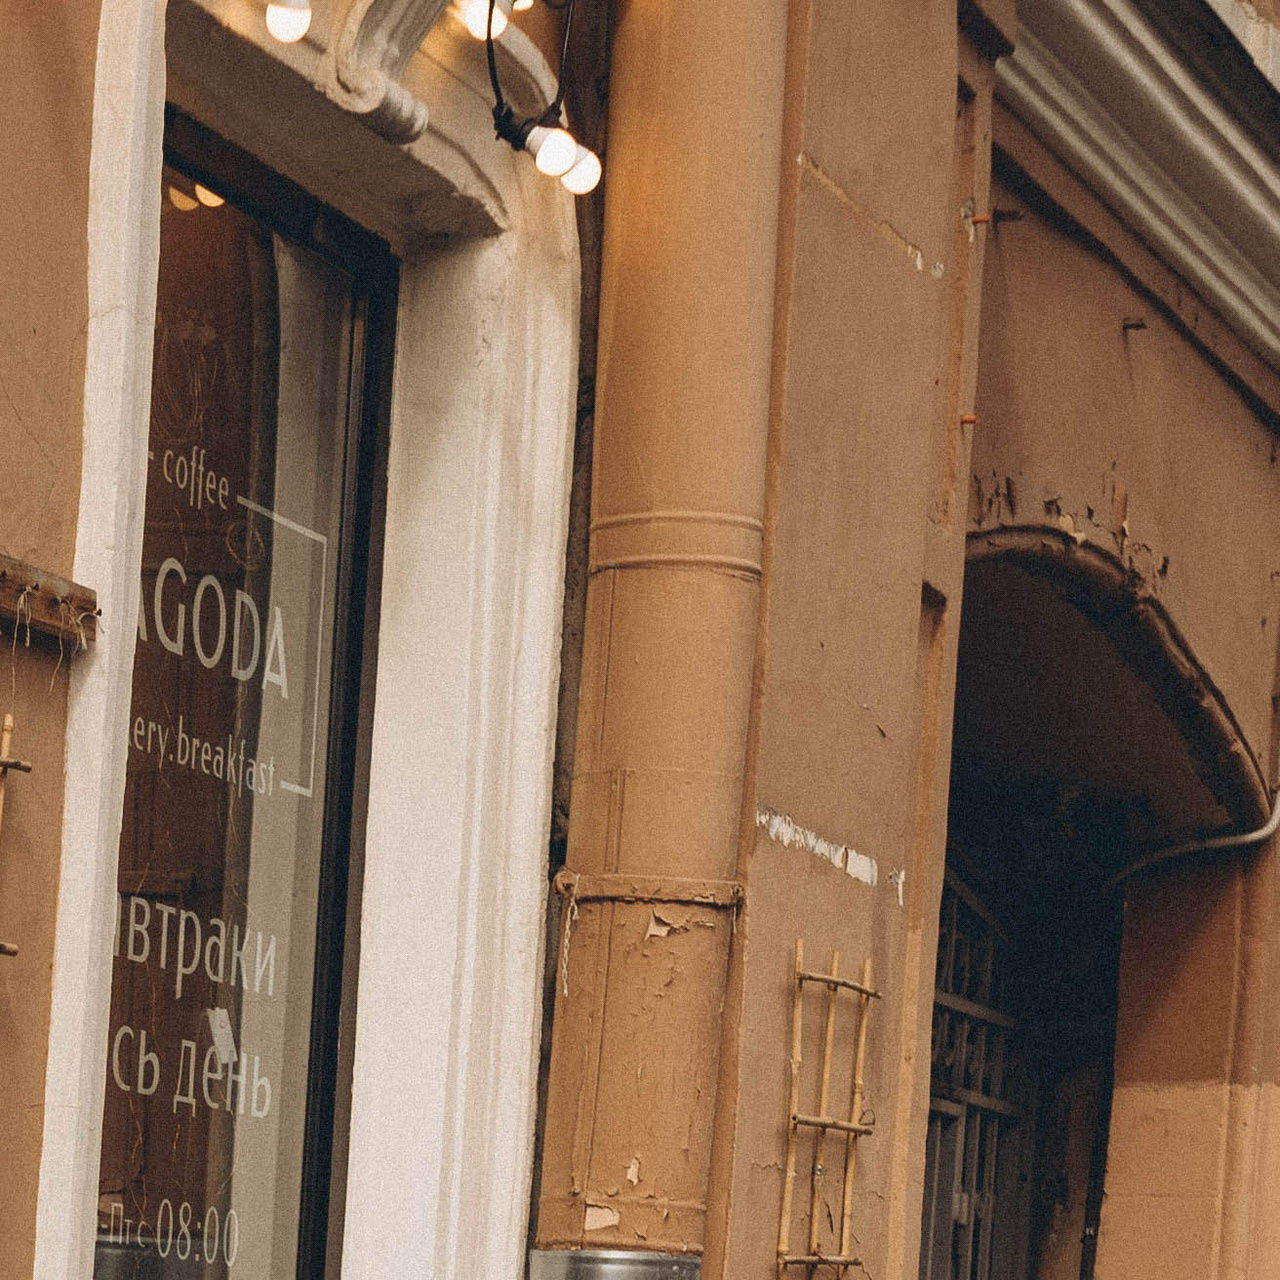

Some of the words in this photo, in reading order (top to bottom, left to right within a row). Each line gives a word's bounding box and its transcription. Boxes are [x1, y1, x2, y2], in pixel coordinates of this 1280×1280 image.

[163, 446, 230, 510] coffee
[128, 715, 275, 799] ery.breakfast
[173, 1039, 272, 1119] день
[157, 1199, 239, 1267] 08:00
